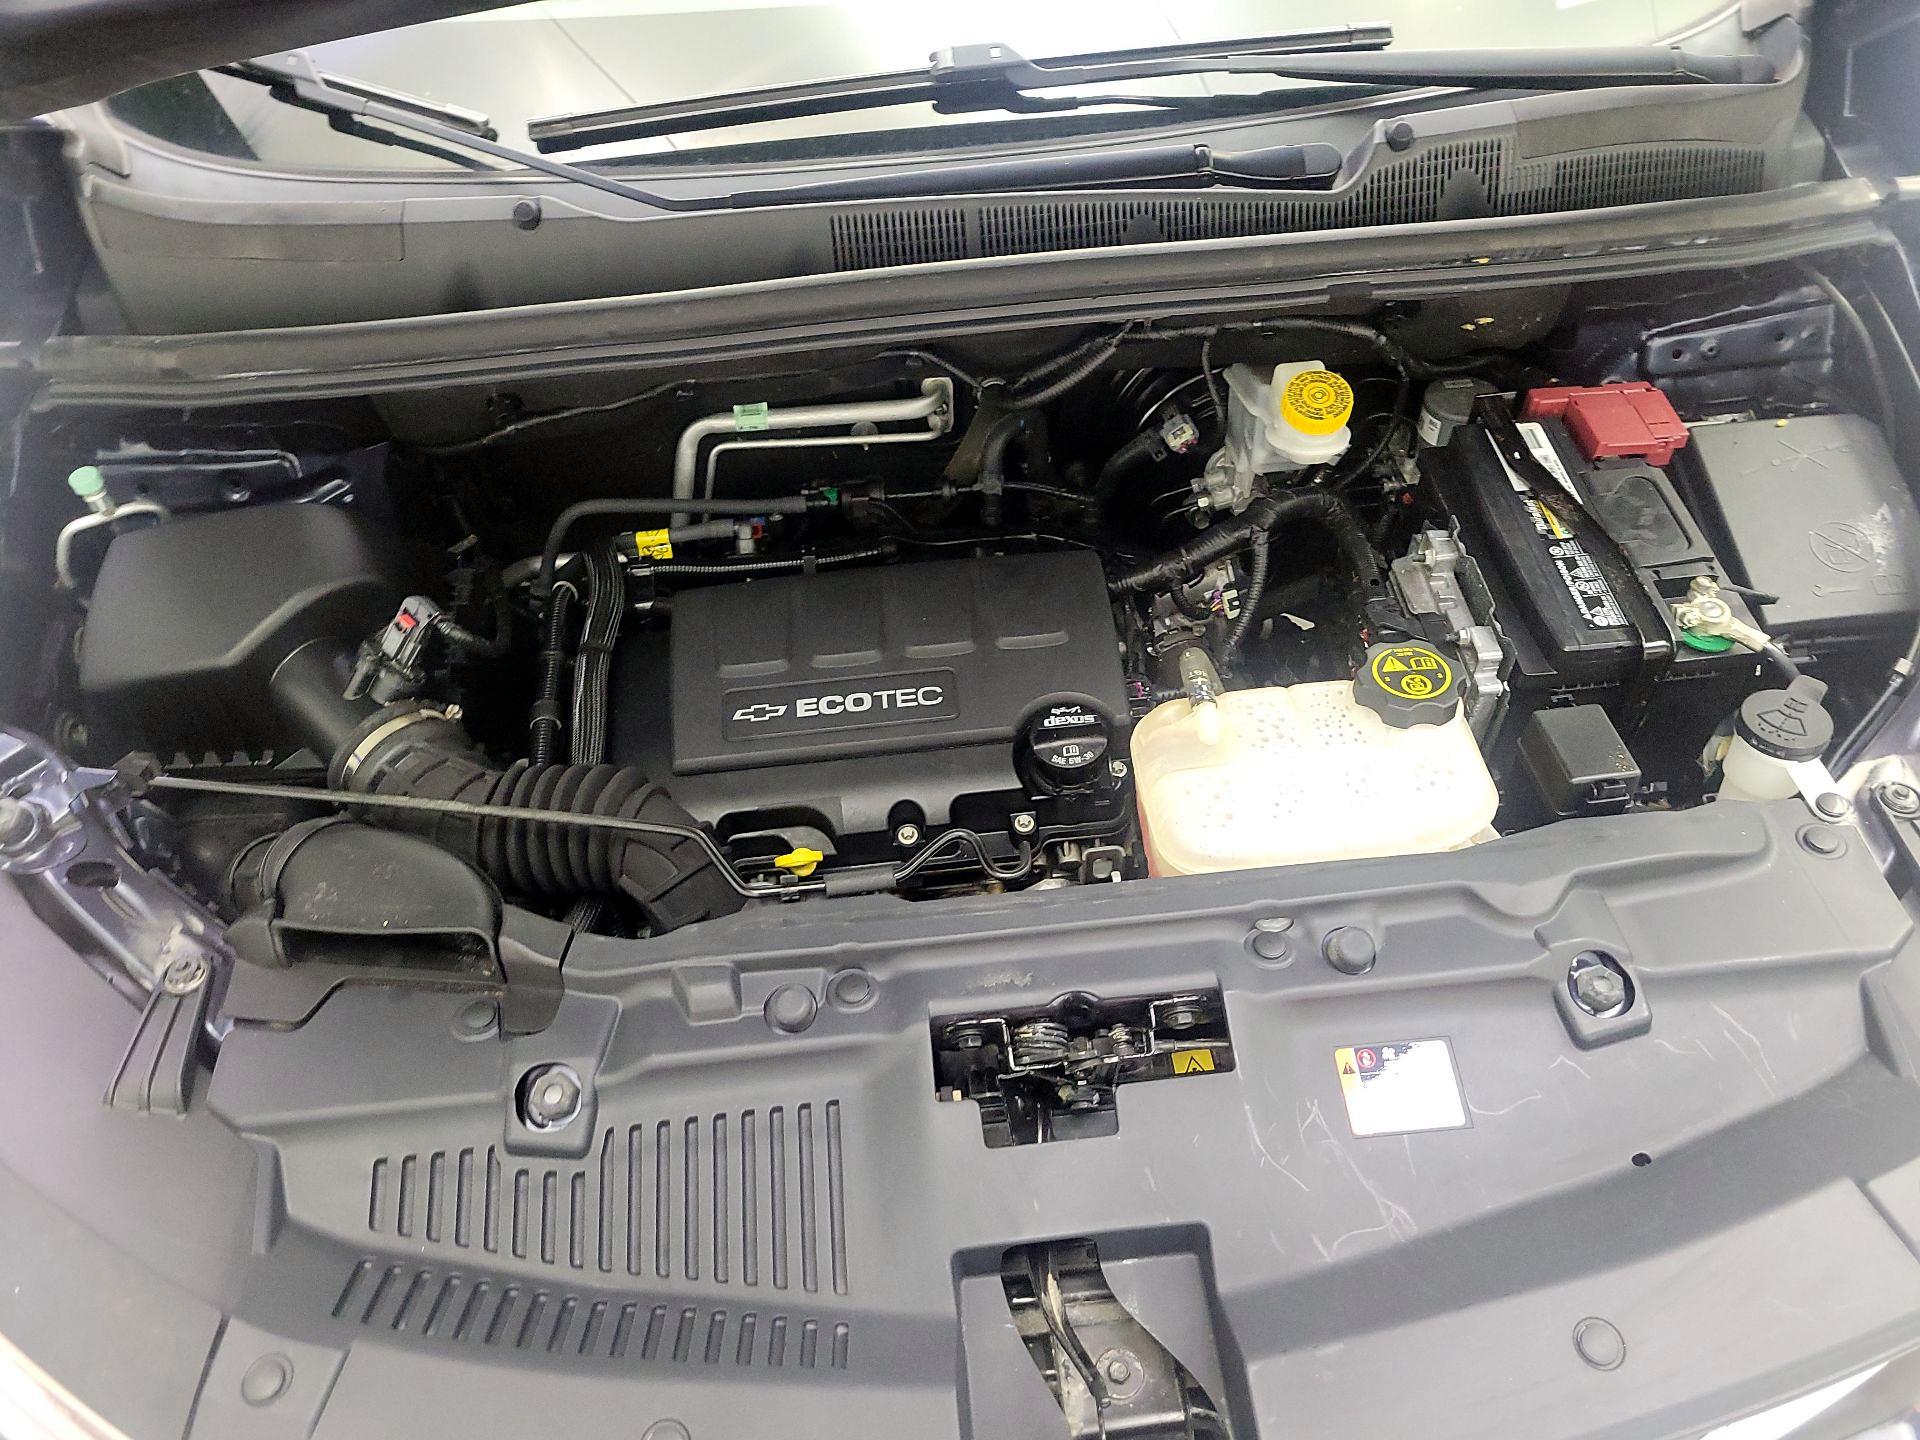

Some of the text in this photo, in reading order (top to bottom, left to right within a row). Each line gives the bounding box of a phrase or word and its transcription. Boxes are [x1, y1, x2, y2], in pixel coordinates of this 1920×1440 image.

[796, 686, 943, 717] ECOTEC
[1043, 715, 1096, 727] dexos
[1051, 751, 1094, 765] SAE 5W-30
